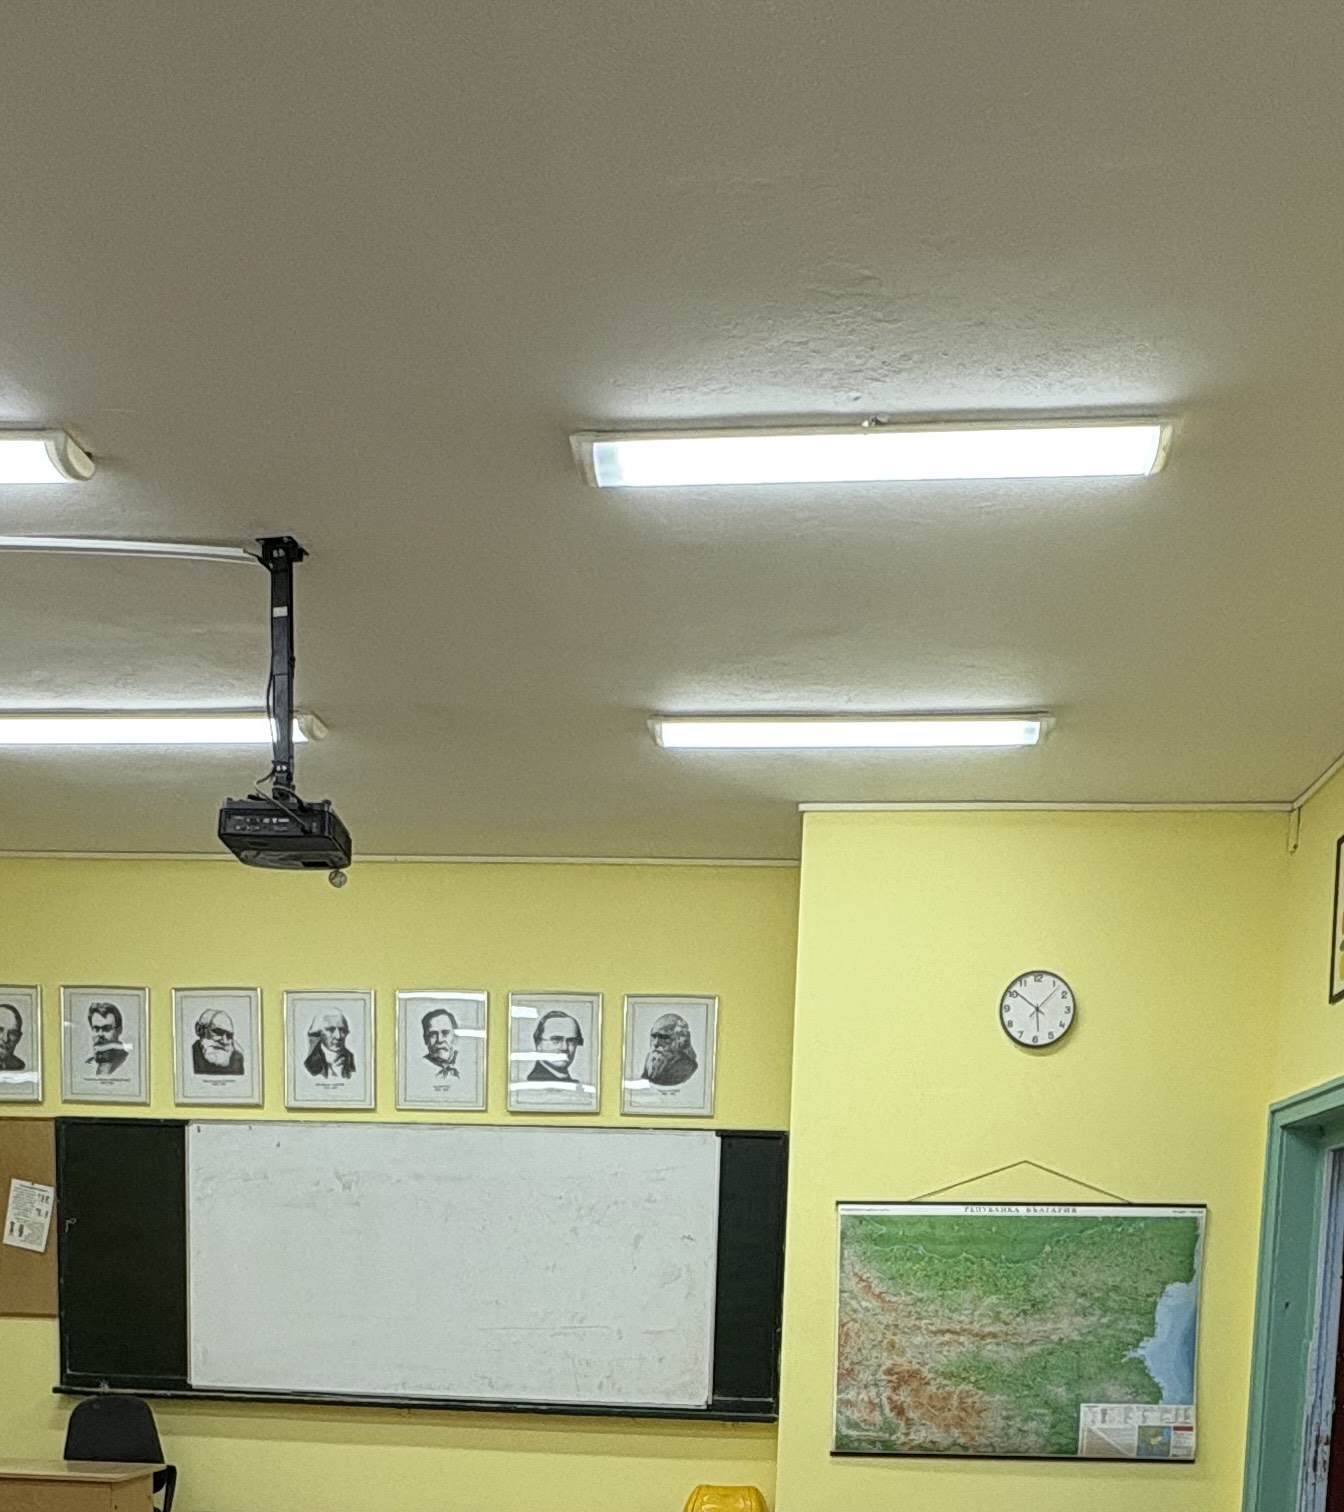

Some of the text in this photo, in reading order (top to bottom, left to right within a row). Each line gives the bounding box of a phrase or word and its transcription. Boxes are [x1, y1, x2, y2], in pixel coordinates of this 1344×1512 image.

[1033, 974, 1044, 983] 12
[1019, 980, 1027, 988] 11
[1061, 990, 1068, 999] 2
[1003, 1004, 1011, 1013] 9
[1064, 1006, 1071, 1014] 3
[1007, 1020, 1014, 1028] 8
[1059, 1020, 1065, 1028] 4
[1017, 1030, 1024, 1039] 7
[1048, 1031, 1054, 1039] 5
[1032, 1036, 1039, 1044] 6
